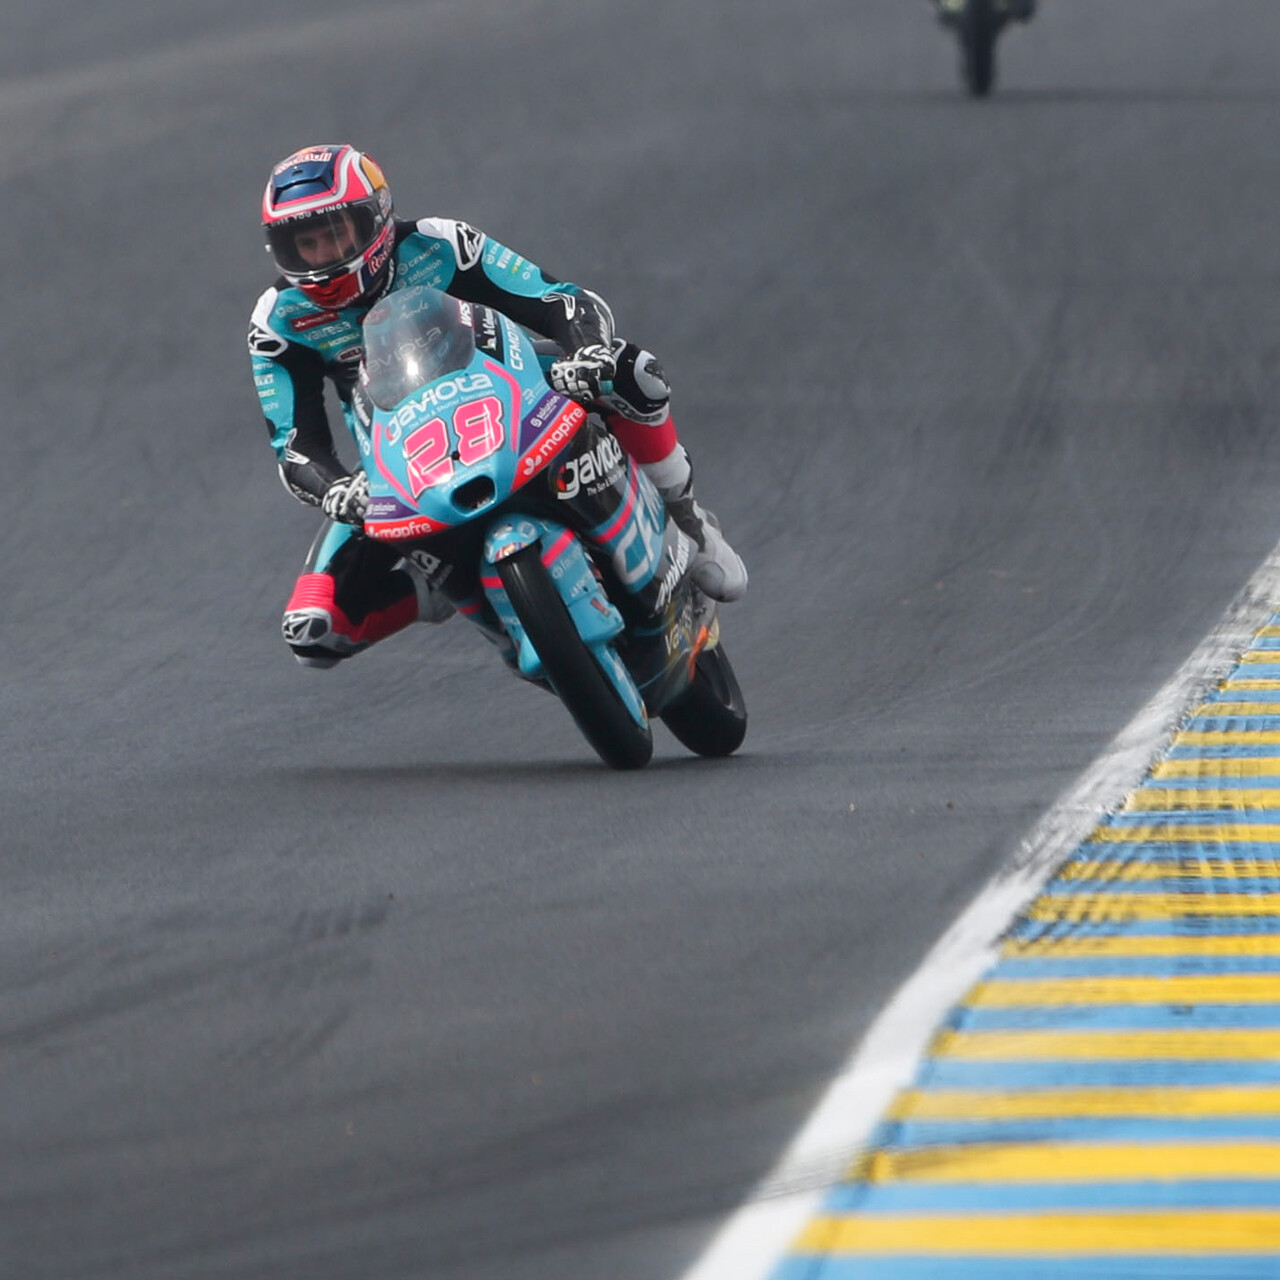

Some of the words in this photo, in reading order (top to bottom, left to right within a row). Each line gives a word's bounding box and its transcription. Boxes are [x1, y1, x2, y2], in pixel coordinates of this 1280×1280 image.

[386, 373, 493, 447] gaviota
[539, 406, 584, 456] mapfre
[402, 395, 505, 500] 28
[379, 522, 433, 539] mapfre
